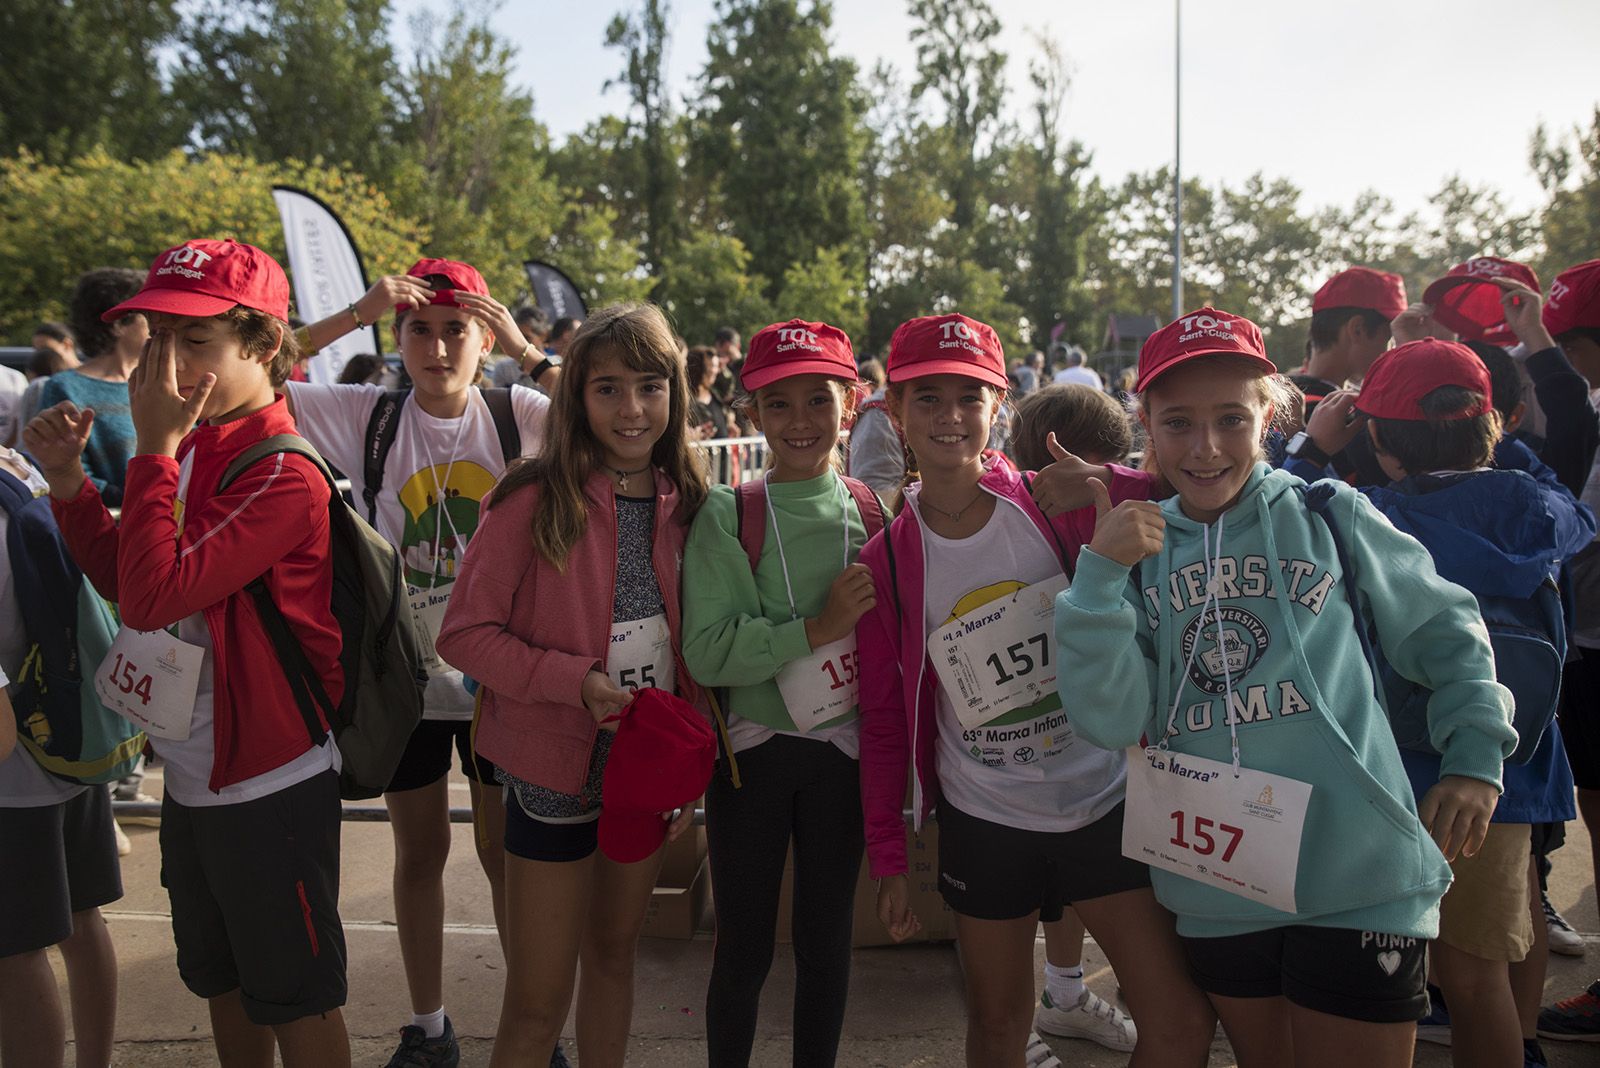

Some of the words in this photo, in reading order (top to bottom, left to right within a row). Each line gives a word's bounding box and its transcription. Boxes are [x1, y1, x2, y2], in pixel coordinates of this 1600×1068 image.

[165, 246, 213, 269] TOT
[939, 321, 981, 345] TOT
[1179, 315, 1232, 333] TOT
[777, 328, 818, 345] TOT
[939, 340, 959, 349] Sant
[1178, 330, 1203, 343] Sant
[777, 341, 796, 353] Sant
[986, 634, 1049, 686] 157
[109, 653, 153, 706] 154
[986, 728, 1030, 743] Marxa
[1147, 755, 1166, 771] “La
[1168, 757, 1220, 783] Marxa”
[1170, 811, 1245, 863] 157
[1361, 930, 1417, 950] PUMA
